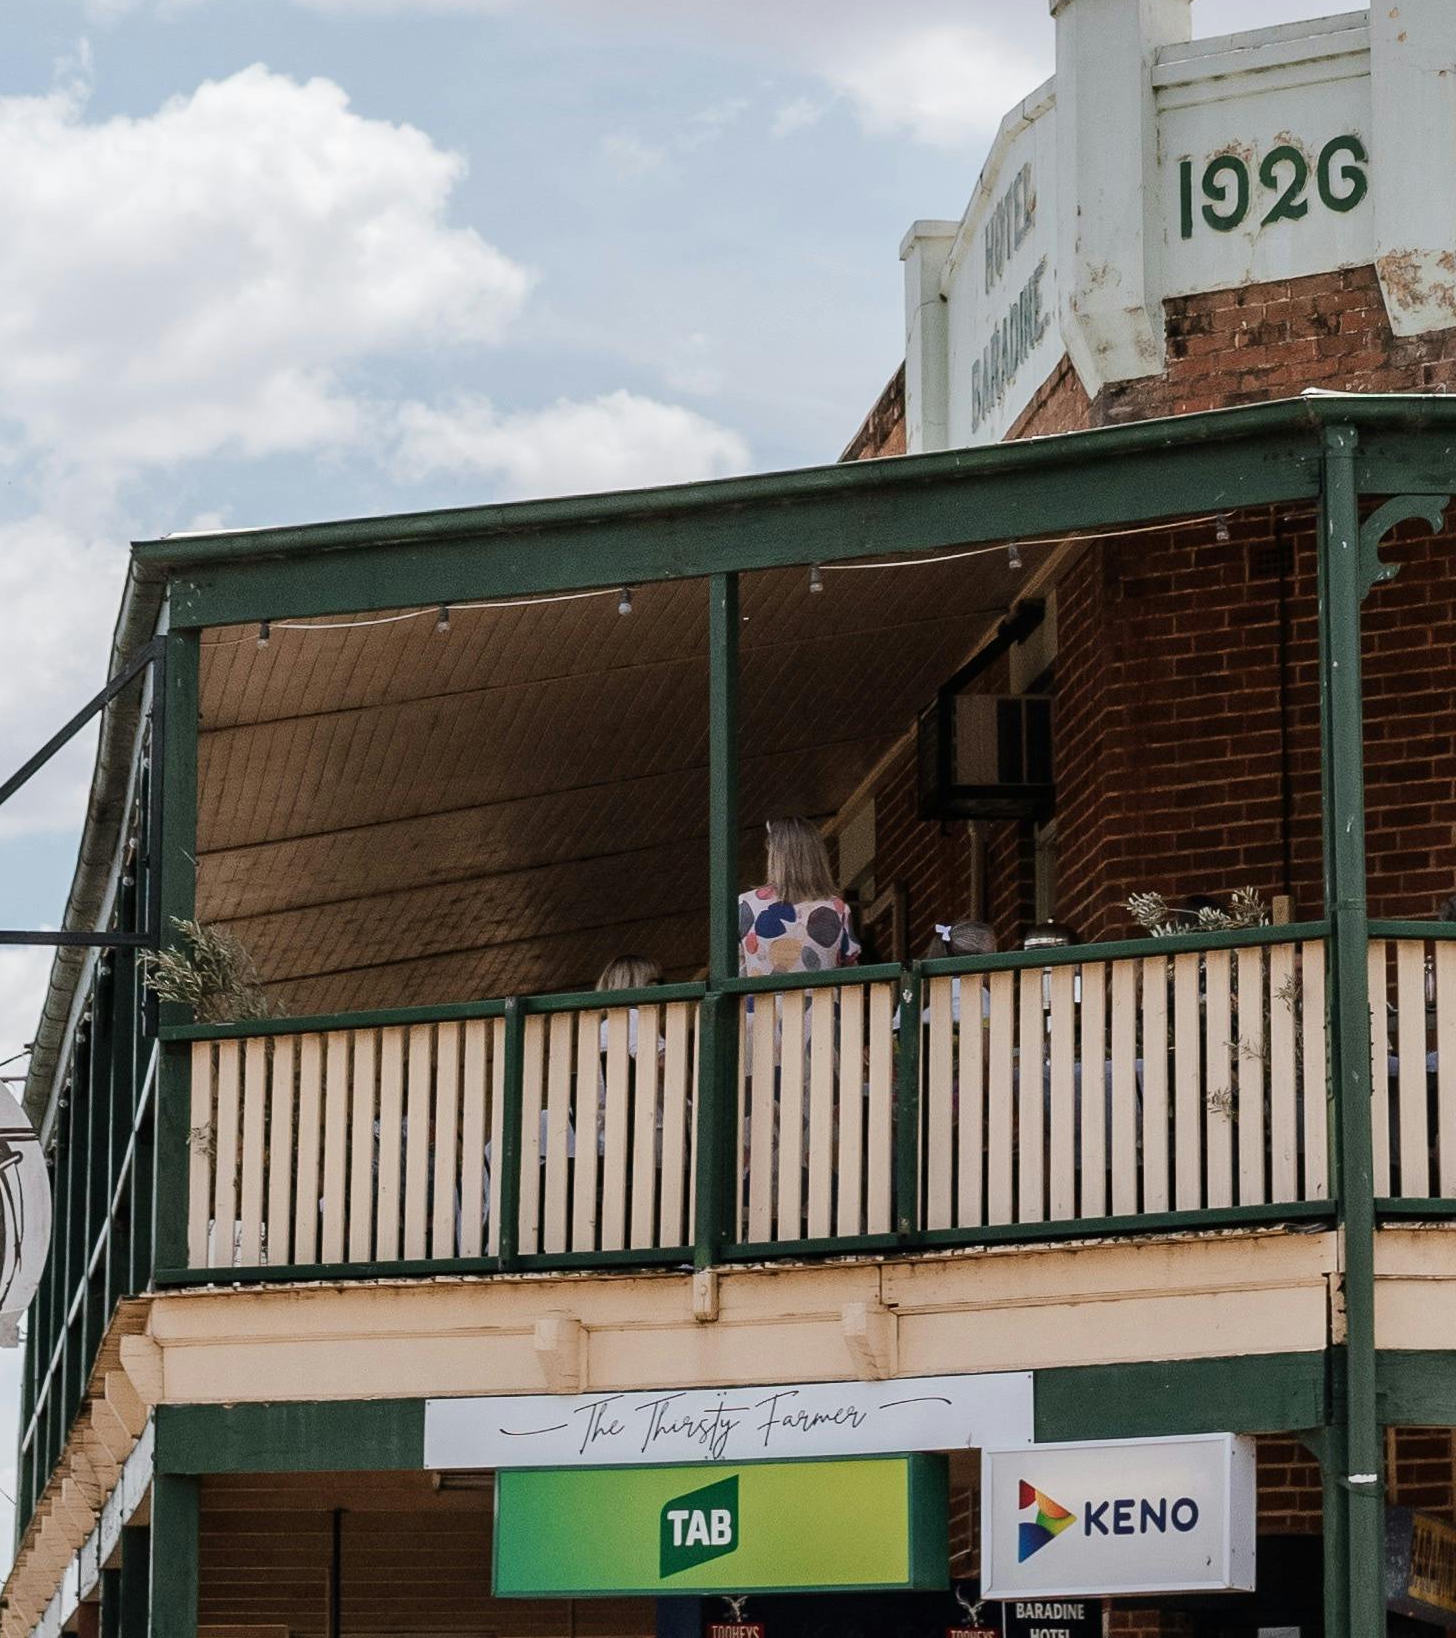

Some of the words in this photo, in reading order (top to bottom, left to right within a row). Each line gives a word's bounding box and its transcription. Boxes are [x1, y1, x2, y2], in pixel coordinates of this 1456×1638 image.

[1179, 134, 1369, 241] 1926
[984, 161, 1037, 295] HOTEL
[573, 1394, 626, 1455] The
[634, 1392, 751, 1459] Thirsty
[755, 1390, 868, 1448] Farmer
[666, 1508, 732, 1548] TAB
[1083, 1497, 1200, 1538] KENO
[1015, 1602, 1086, 1621] BARADINE
